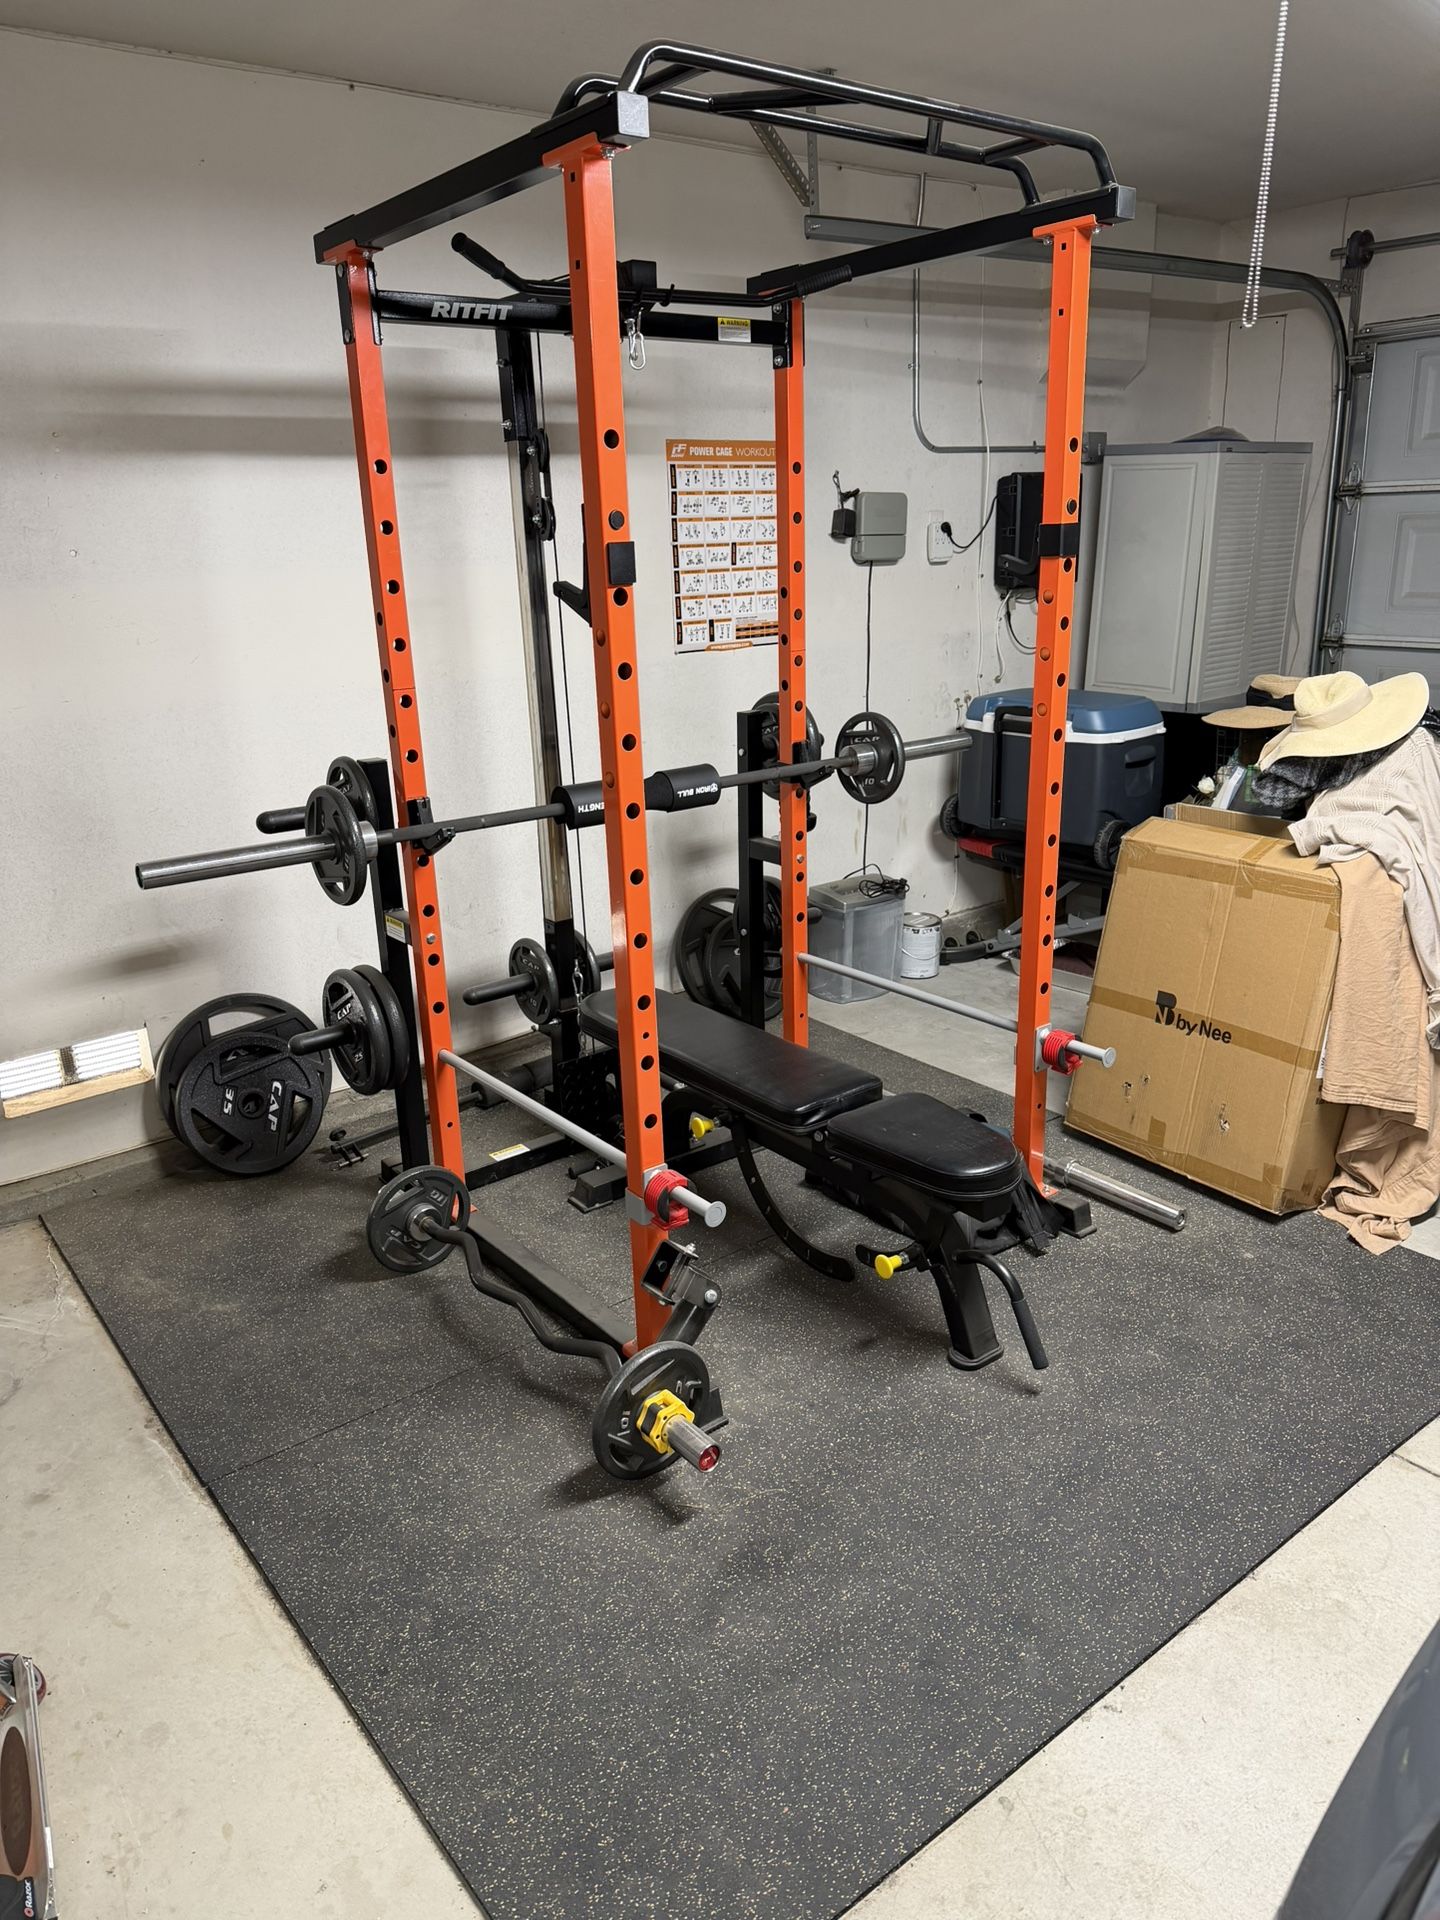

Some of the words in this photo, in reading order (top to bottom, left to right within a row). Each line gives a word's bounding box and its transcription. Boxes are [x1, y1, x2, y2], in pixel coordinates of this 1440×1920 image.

[431, 301, 513, 321] RITFIT
[689, 446, 714, 456] POWER
[716, 446, 733, 457] CAGE
[735, 447, 776, 457] WORKOUT
[864, 777, 875, 785] 10
[677, 788, 694, 798] BULL
[695, 784, 712, 795] IRON
[522, 958, 540, 970] CAP
[337, 1003, 352, 1020] CAP
[1175, 1013, 1198, 1036] by
[1198, 1020, 1232, 1044] Nee
[355, 1051, 364, 1063] 25
[223, 1088, 234, 1115] 35
[268, 1081, 282, 1131] CAP
[430, 1190, 445, 1201] 10
[617, 1416, 630, 1436] 10
[24, 1879, 34, 1908] Razor
